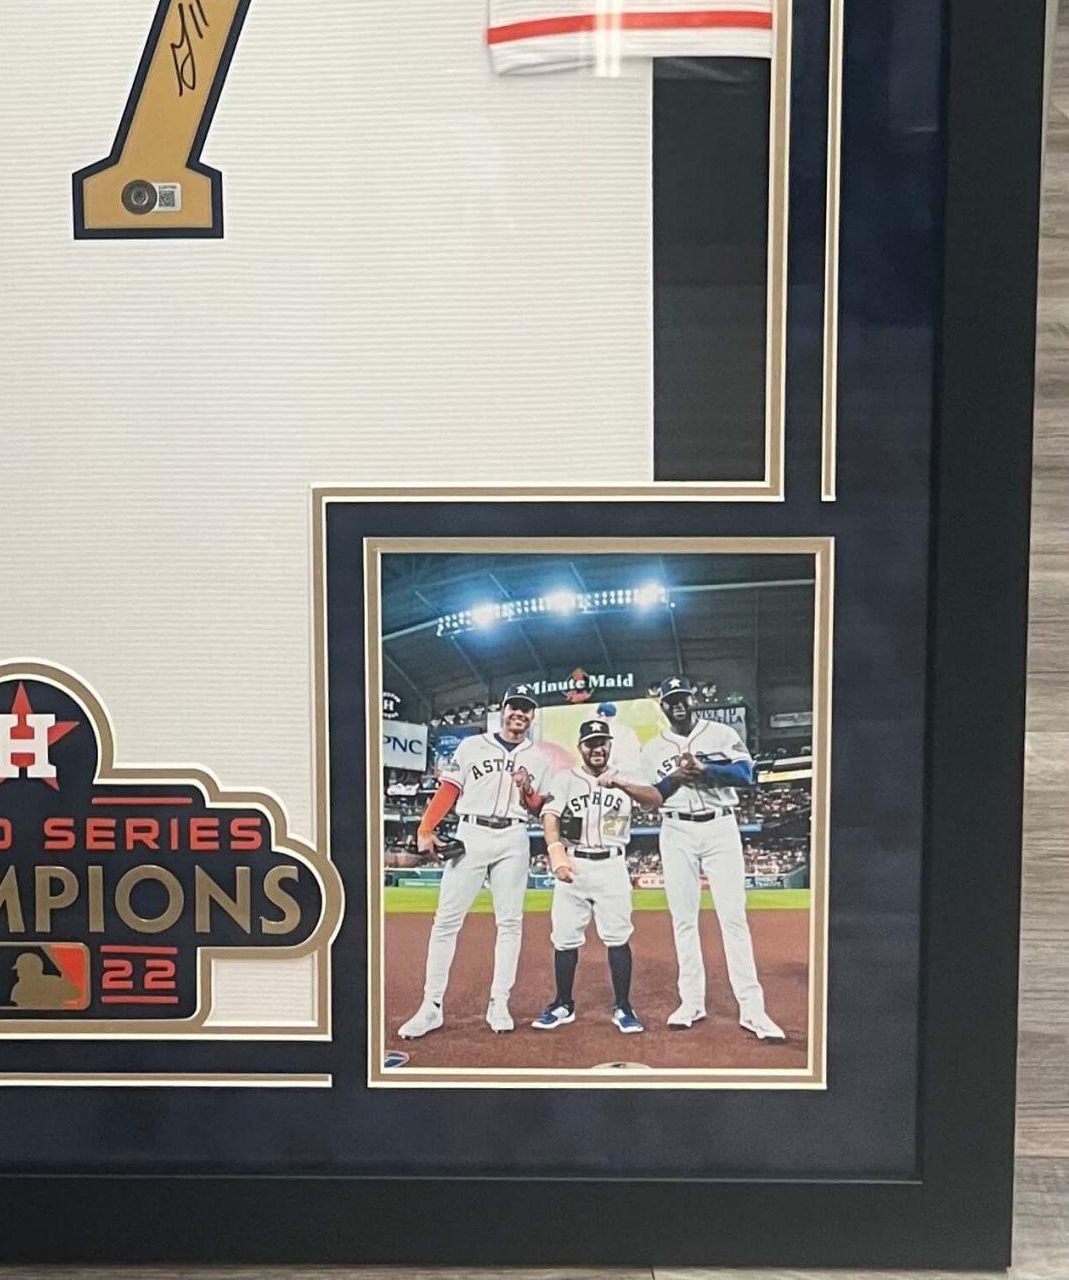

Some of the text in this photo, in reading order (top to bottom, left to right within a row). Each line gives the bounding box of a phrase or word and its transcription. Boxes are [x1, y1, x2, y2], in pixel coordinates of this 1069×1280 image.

[588, 673, 634, 689] Maid
[570, 791, 623, 812] STROS
[43, 816, 262, 851] SERIES
[602, 815, 630, 836] 27
[101, 957, 178, 989] 22
